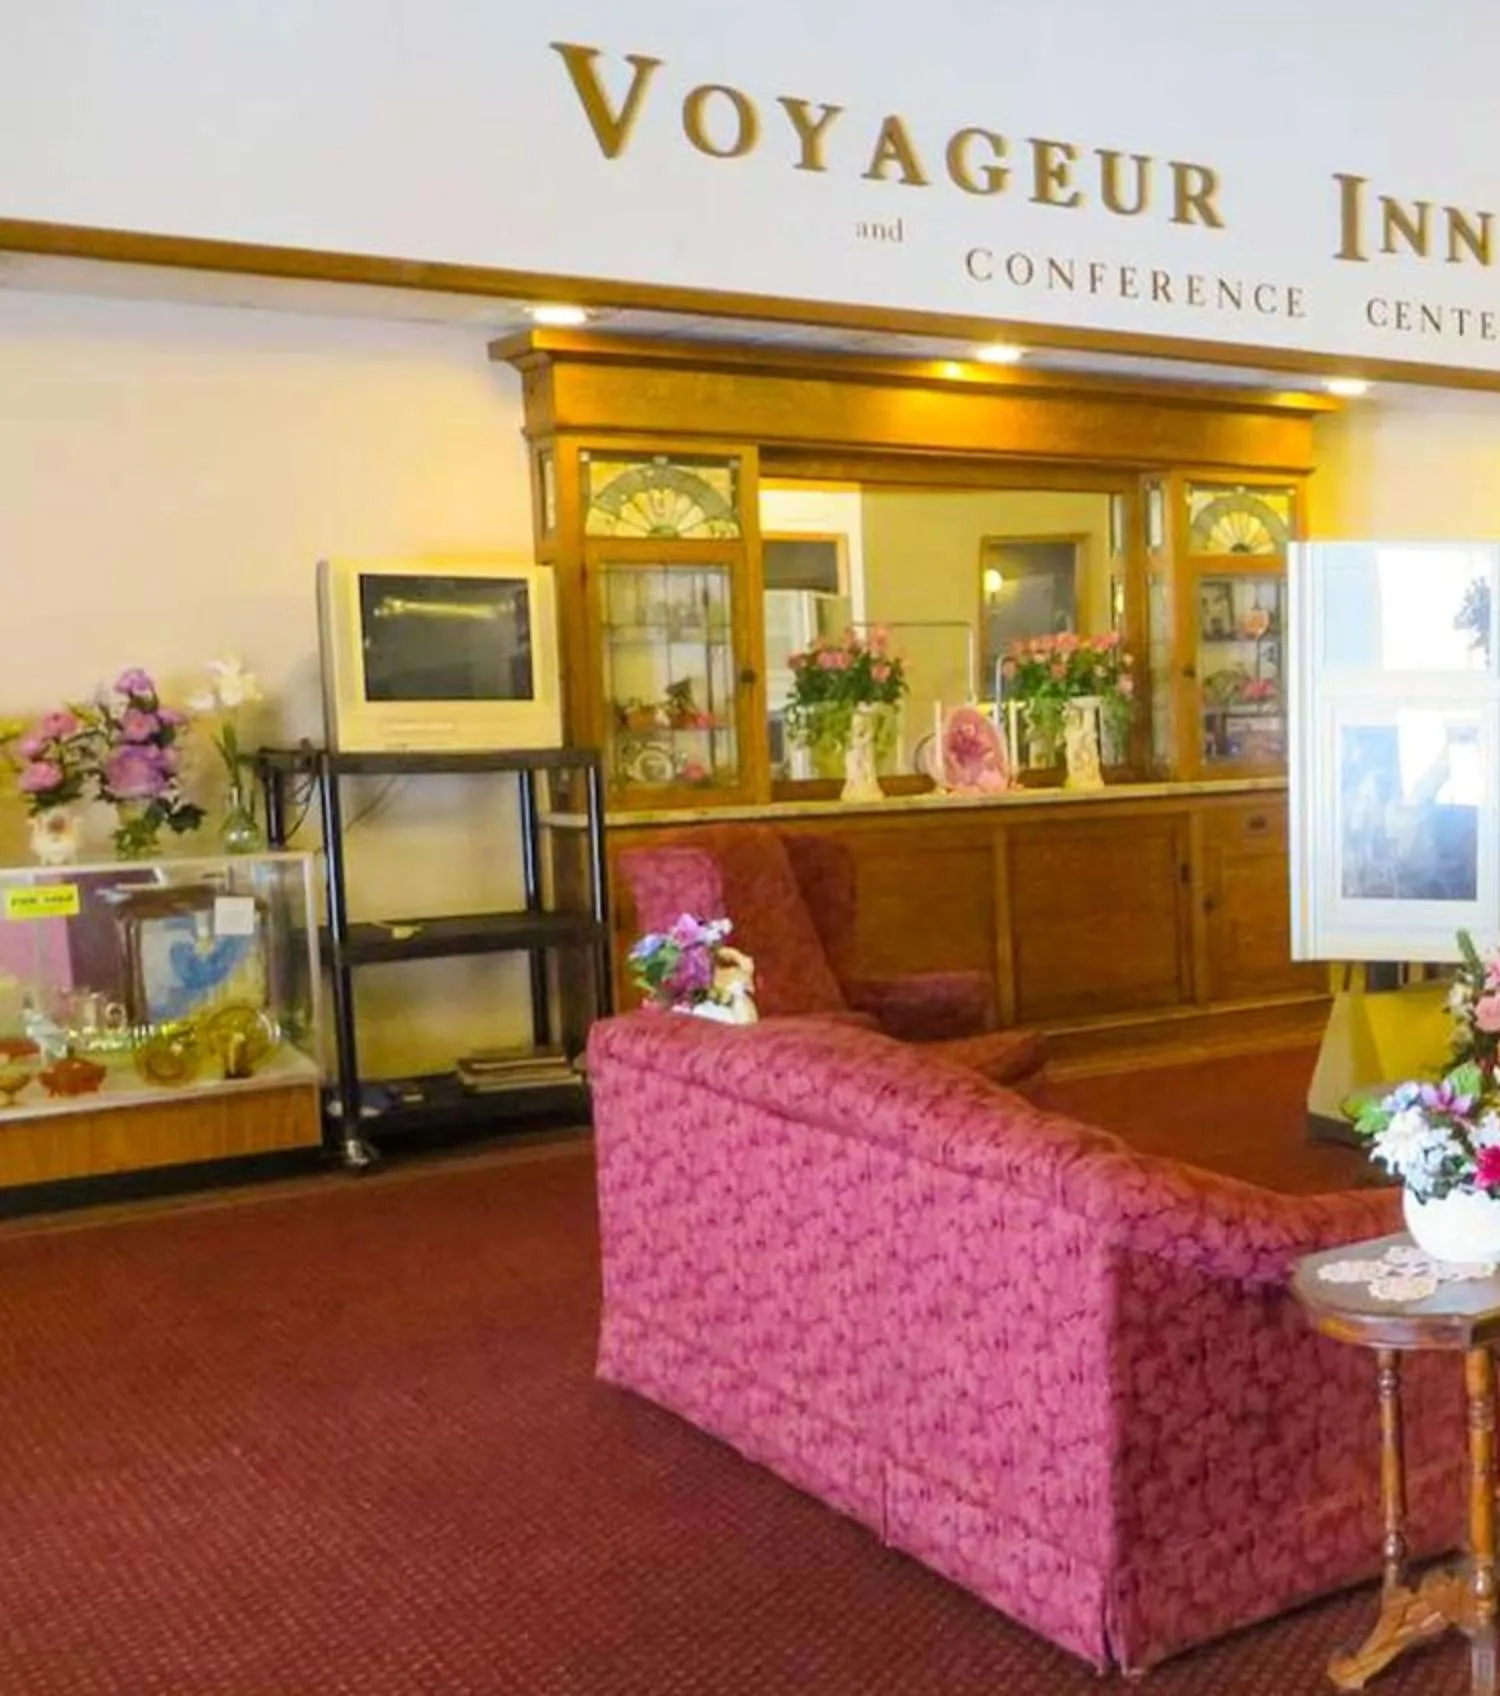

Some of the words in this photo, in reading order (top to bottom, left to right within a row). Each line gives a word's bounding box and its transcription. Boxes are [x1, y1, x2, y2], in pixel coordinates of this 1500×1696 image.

[549, 41, 1226, 230] VOYAGEUR
[1332, 173, 1497, 268] INN
[856, 217, 904, 243] and
[965, 248, 1306, 318] CONFERENCE
